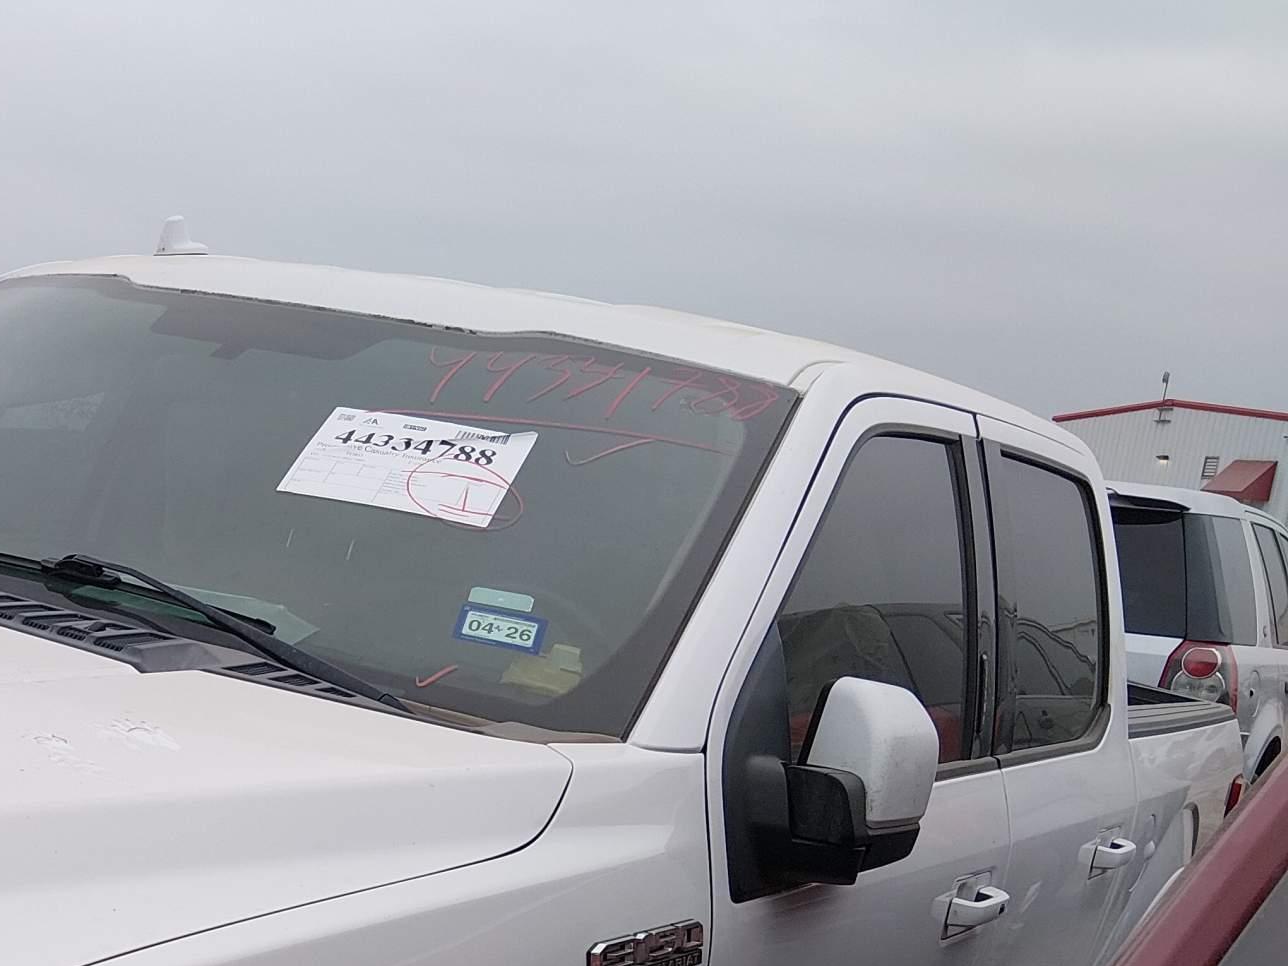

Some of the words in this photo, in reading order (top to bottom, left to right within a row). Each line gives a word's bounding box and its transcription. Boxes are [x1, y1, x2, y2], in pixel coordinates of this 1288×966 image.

[334, 430, 497, 466] 44334788
[468, 619, 494, 634] 04
[504, 626, 533, 642] 26
